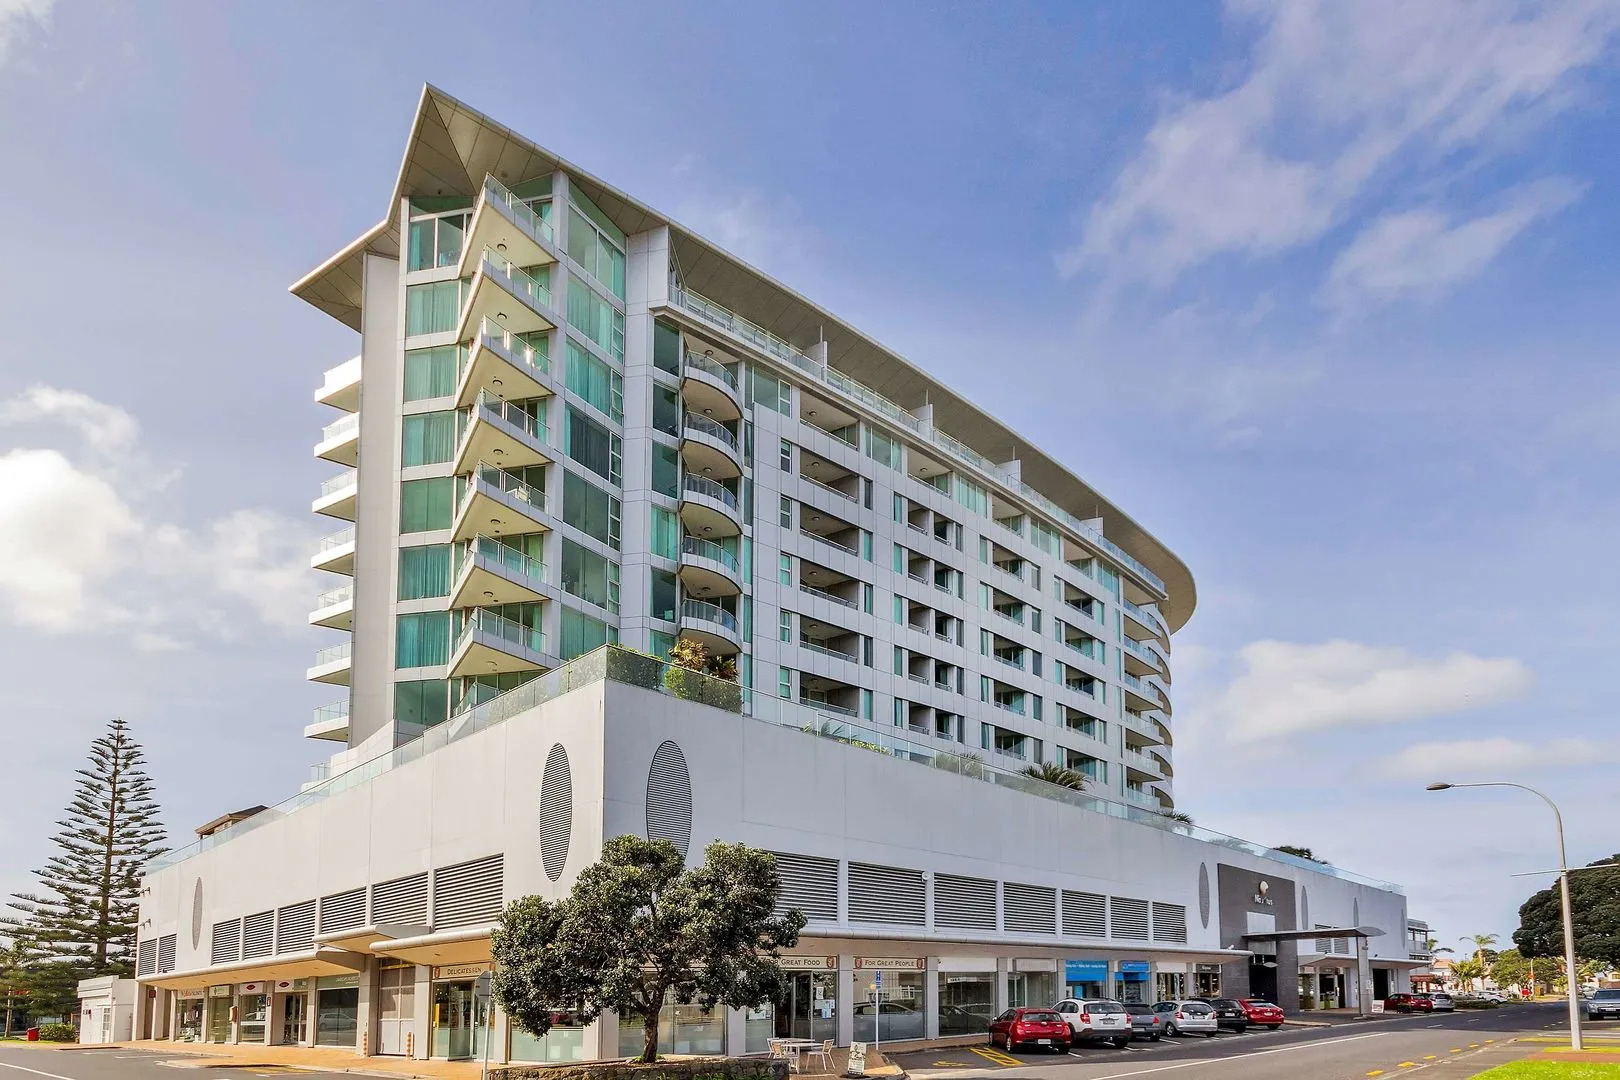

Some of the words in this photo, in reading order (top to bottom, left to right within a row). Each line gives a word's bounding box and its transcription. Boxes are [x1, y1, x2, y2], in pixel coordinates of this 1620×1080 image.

[781, 958, 802, 966] GREAT
[876, 959, 894, 967] GREAT
[447, 966, 482, 976] DELICATESSEN
